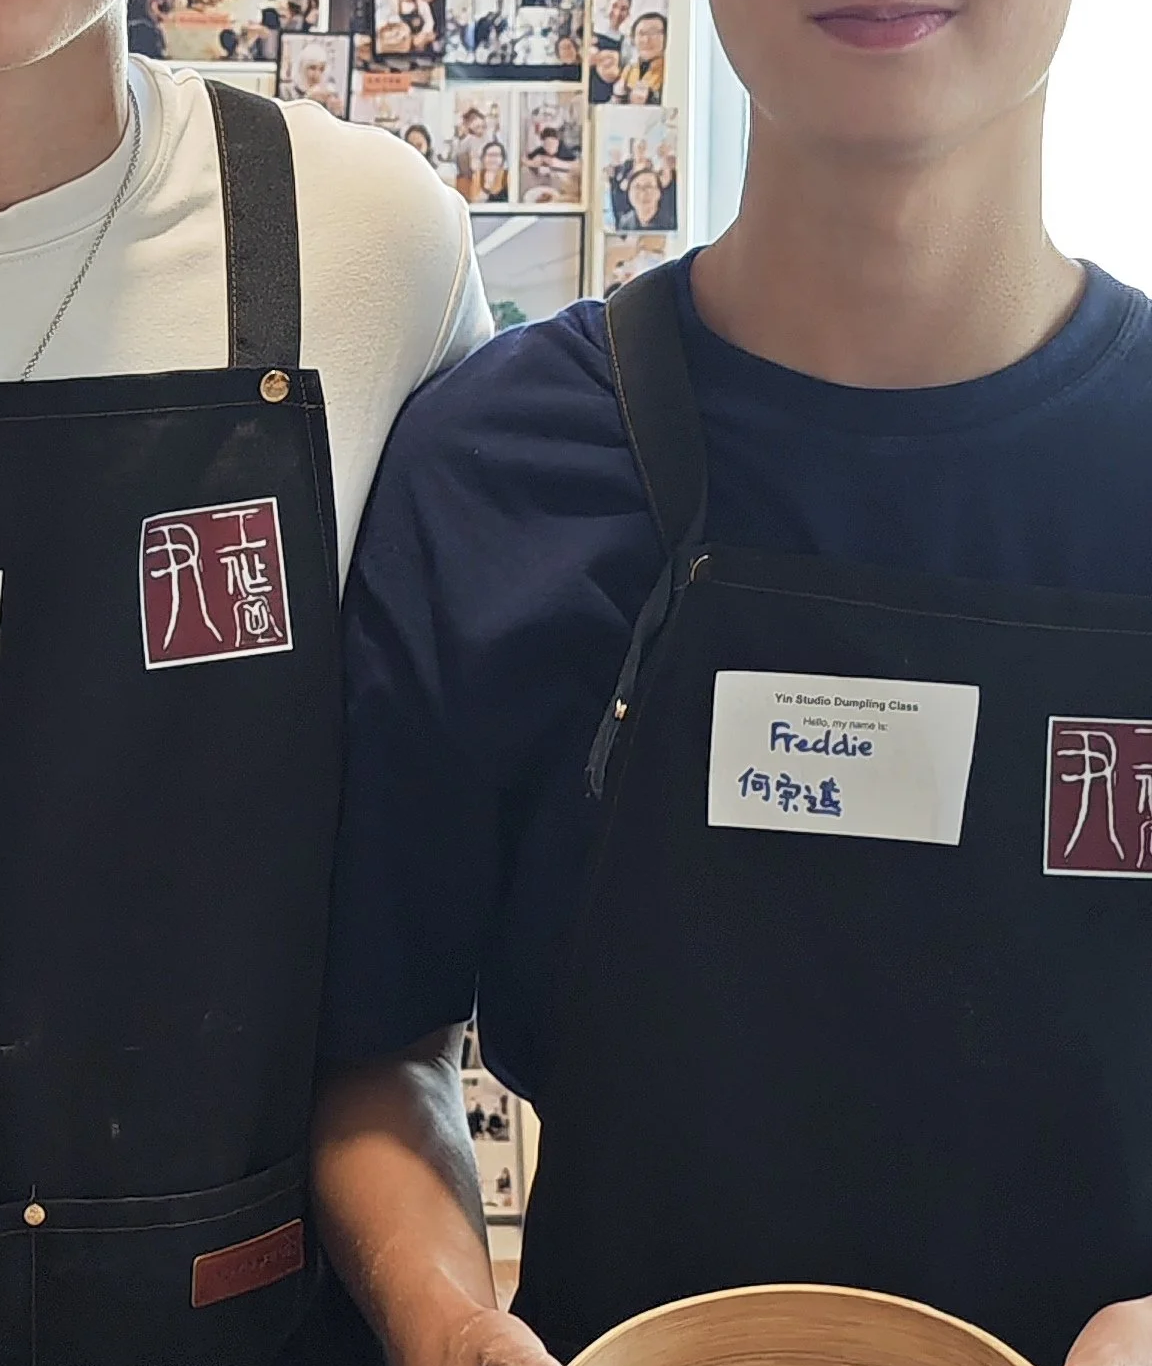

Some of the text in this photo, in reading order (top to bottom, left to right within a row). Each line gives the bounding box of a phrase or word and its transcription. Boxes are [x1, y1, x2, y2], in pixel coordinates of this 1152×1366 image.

[775, 692, 919, 712] Yin Studio Dumpling Class
[802, 716, 830, 729] Hello,
[832, 720, 848, 731] my
[849, 721, 875, 730] name
[770, 721, 874, 757] Freddie
